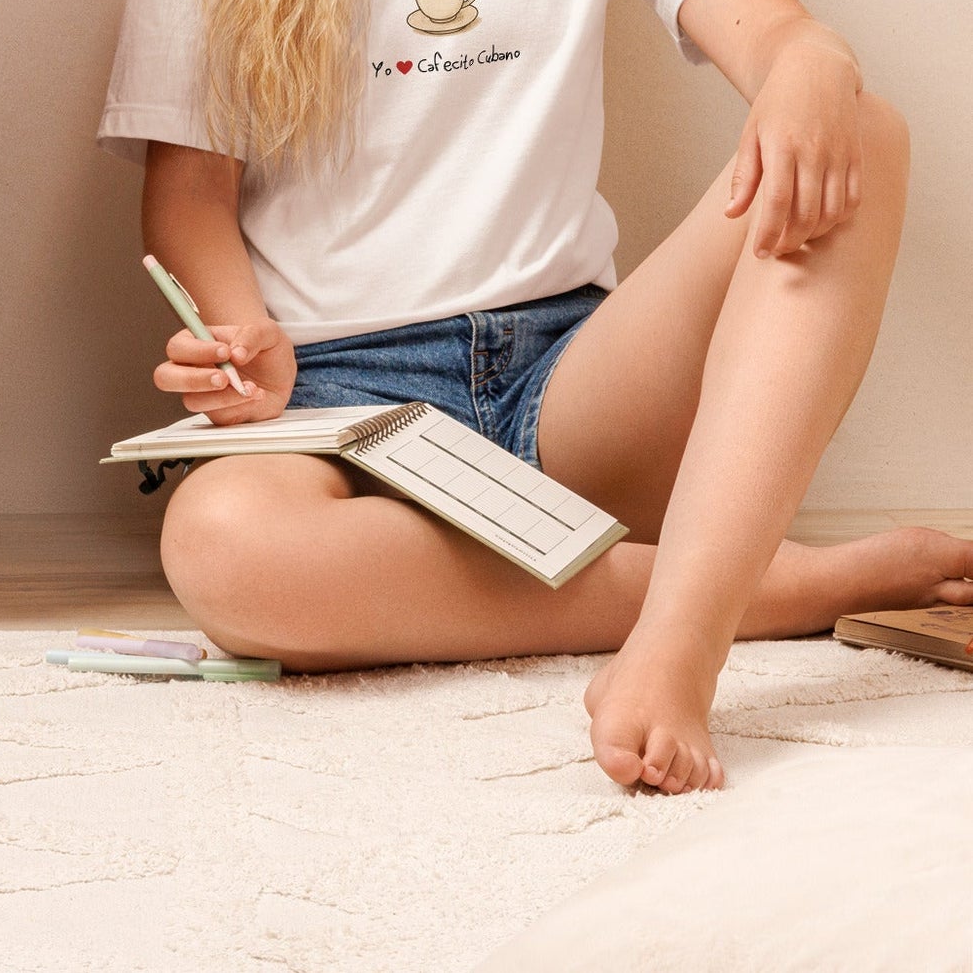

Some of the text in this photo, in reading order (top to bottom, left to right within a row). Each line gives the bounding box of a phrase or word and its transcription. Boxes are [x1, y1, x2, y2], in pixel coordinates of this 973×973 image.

[371, 44, 521, 78] Yo Cafecito Cubano
